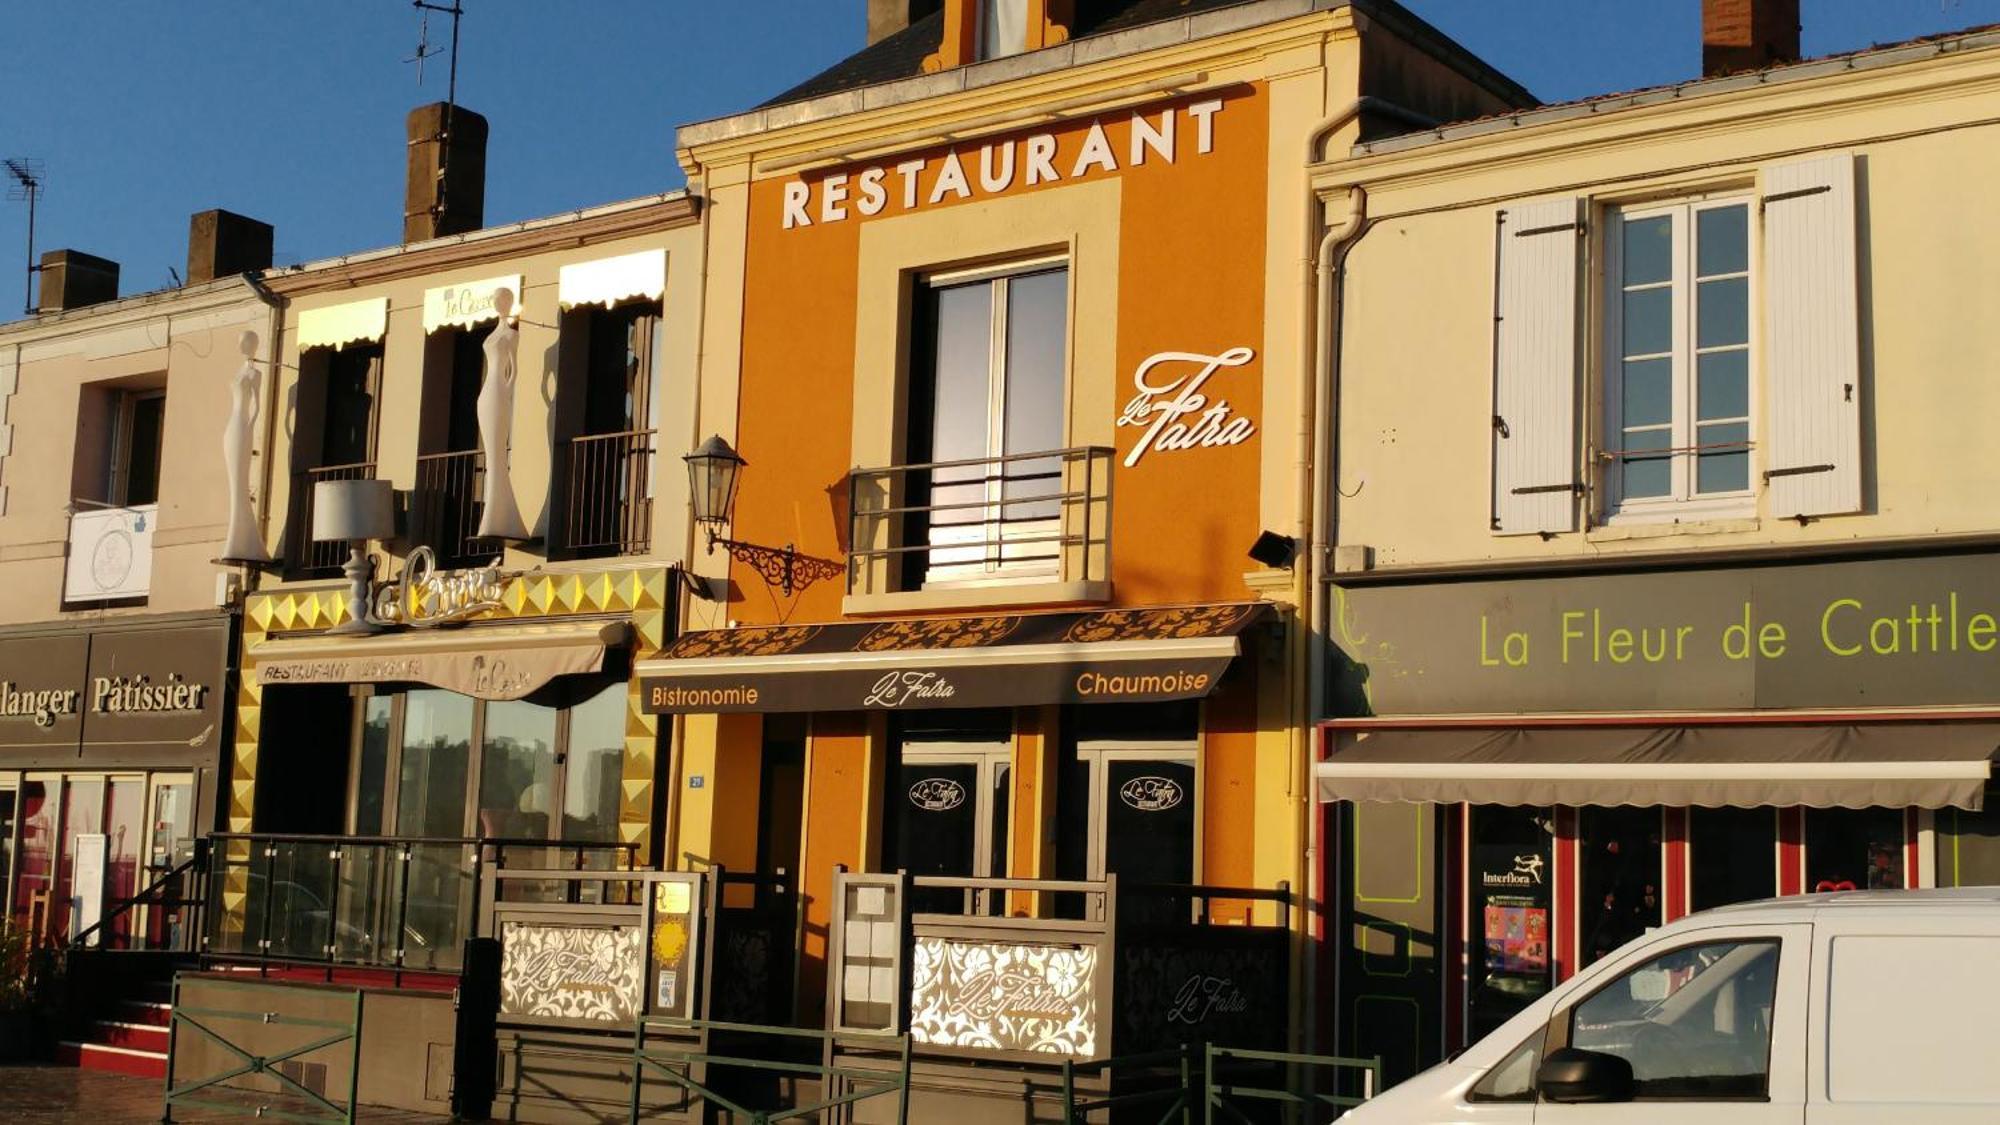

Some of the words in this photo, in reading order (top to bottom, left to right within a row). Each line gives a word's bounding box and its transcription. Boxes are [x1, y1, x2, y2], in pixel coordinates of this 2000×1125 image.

[783, 98, 1224, 230] RESTAURANT
[1117, 391, 1151, 427] Le
[1123, 347, 1255, 468] Fatra
[1481, 615, 1529, 667] La
[1561, 607, 1694, 664] Fleur
[1723, 601, 1786, 660] de
[1820, 591, 1997, 657] Cattle
[91, 672, 202, 712] Pâtissier
[652, 685, 758, 706] Bistronomie
[863, 671, 899, 707] Le
[898, 671, 955, 706] Fatra
[1076, 670, 1209, 695] Chaumoise
[1483, 871, 1530, 884] Interflora
